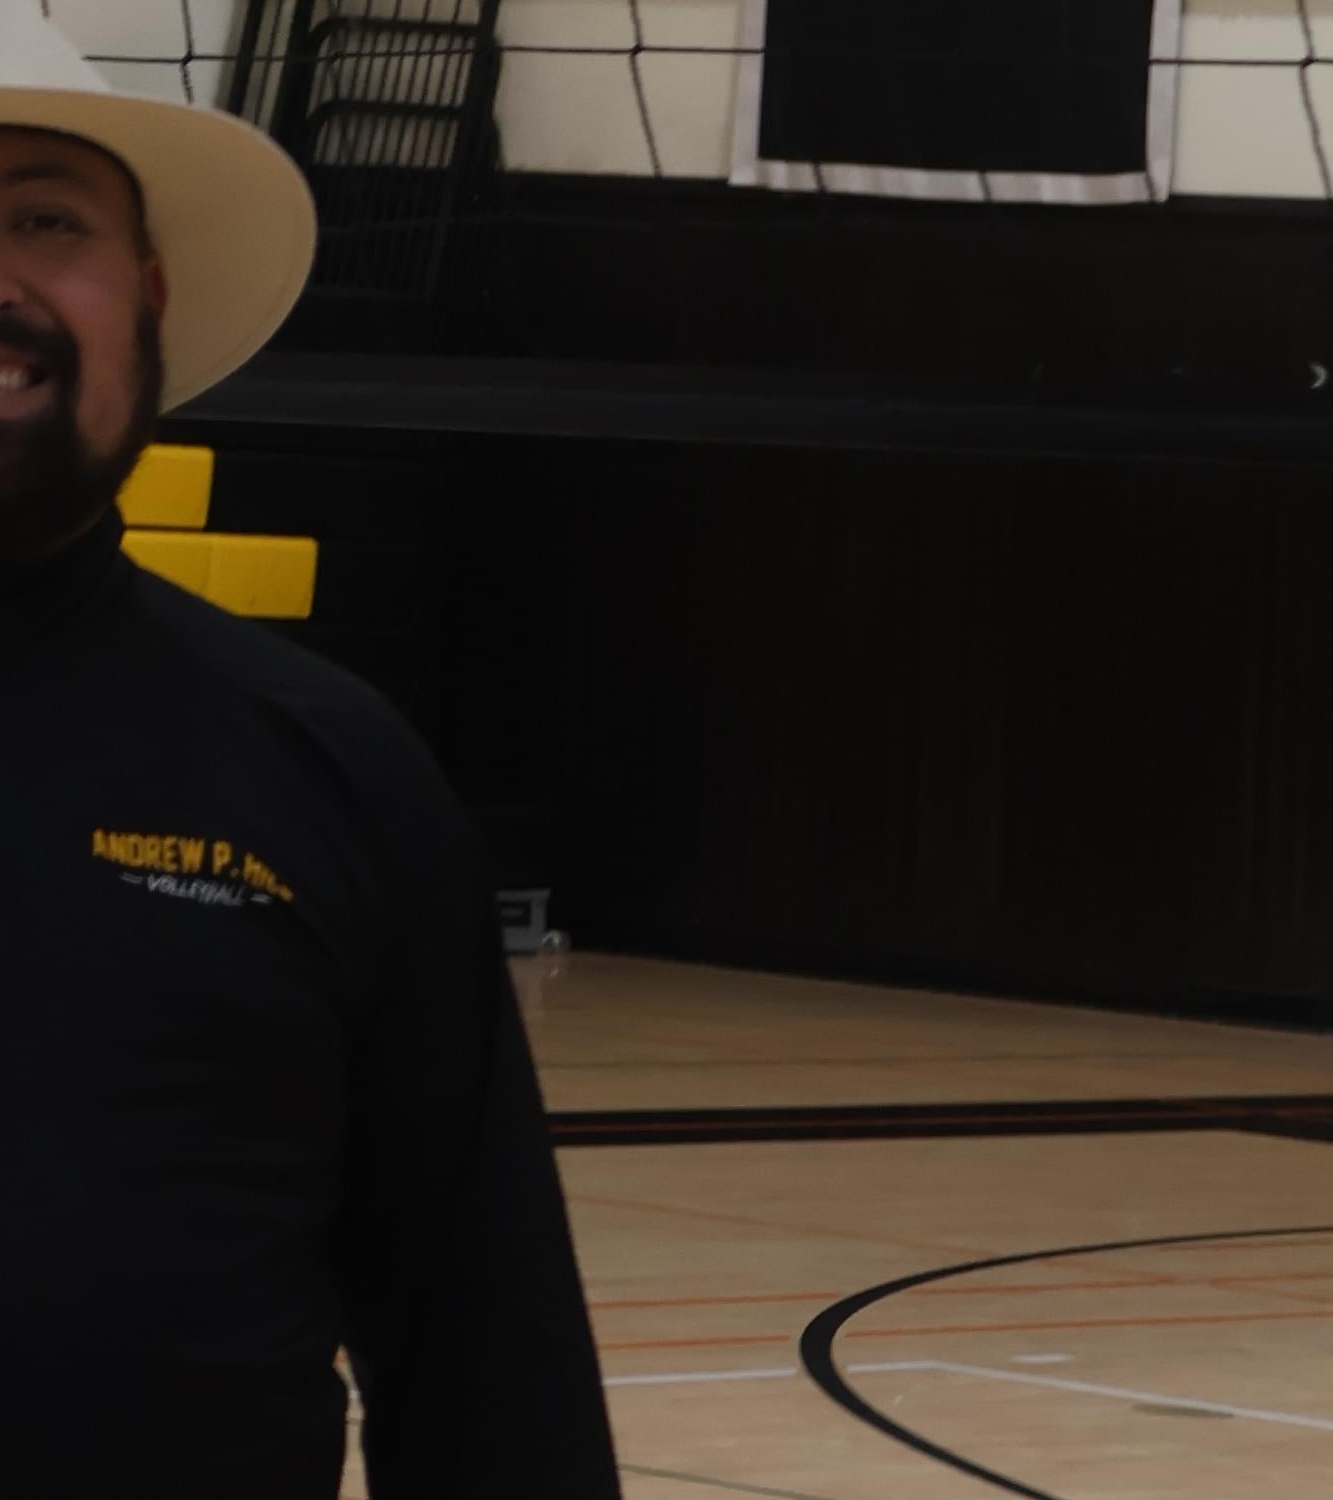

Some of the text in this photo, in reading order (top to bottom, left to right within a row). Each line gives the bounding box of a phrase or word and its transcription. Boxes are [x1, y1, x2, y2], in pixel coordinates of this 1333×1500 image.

[92, 828, 205, 874] ANDREW
[212, 840, 240, 878] P.
[147, 873, 246, 907] VOLLEYBALL
